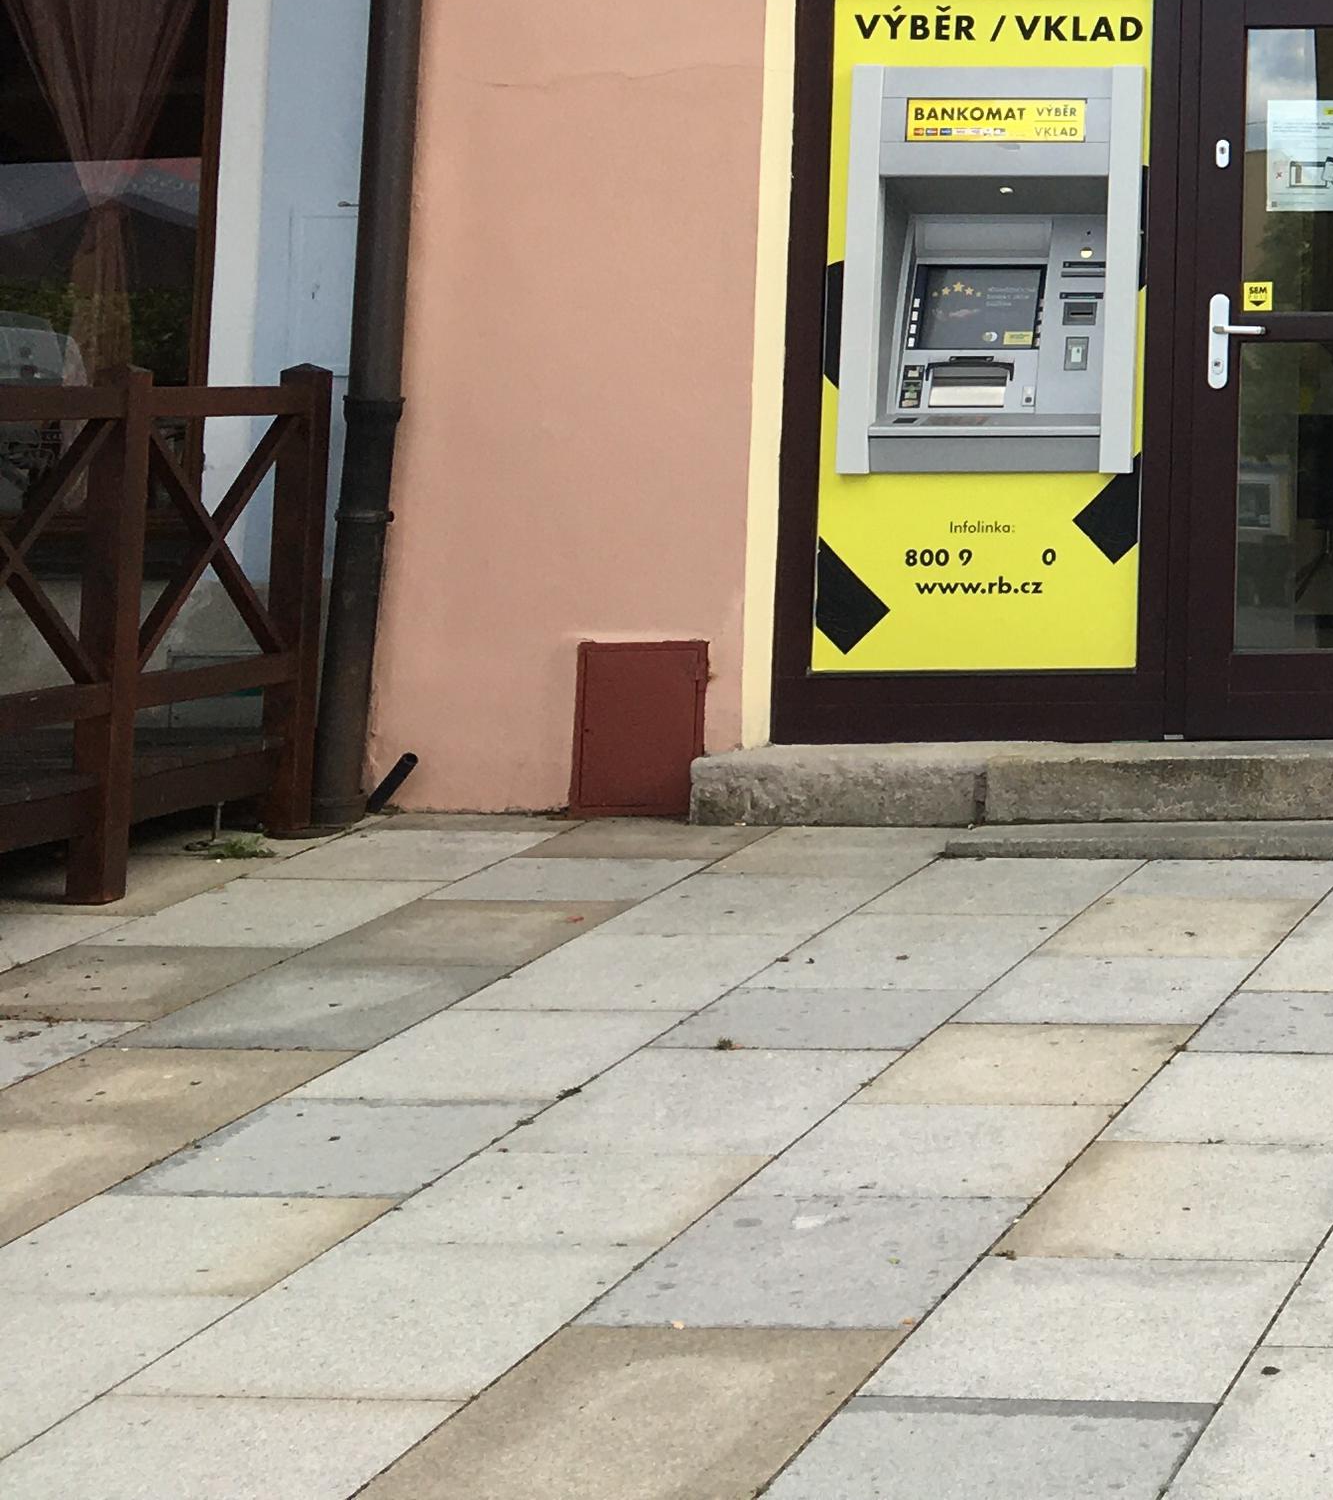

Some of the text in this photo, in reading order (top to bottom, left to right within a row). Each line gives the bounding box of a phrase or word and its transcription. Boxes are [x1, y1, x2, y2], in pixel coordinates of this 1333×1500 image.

[854, 4, 976, 41] VÝBĚR
[1015, 15, 1143, 42] VKLAD
[913, 107, 1026, 121] BANKOMAT
[1036, 104, 1077, 117] VÝBĚR
[1034, 127, 1078, 137] VKLAD
[1248, 286, 1268, 294] SEM
[949, 521, 1016, 534] Infolinka:
[905, 549, 949, 567] 800
[916, 576, 1043, 595] www.rb.cz
